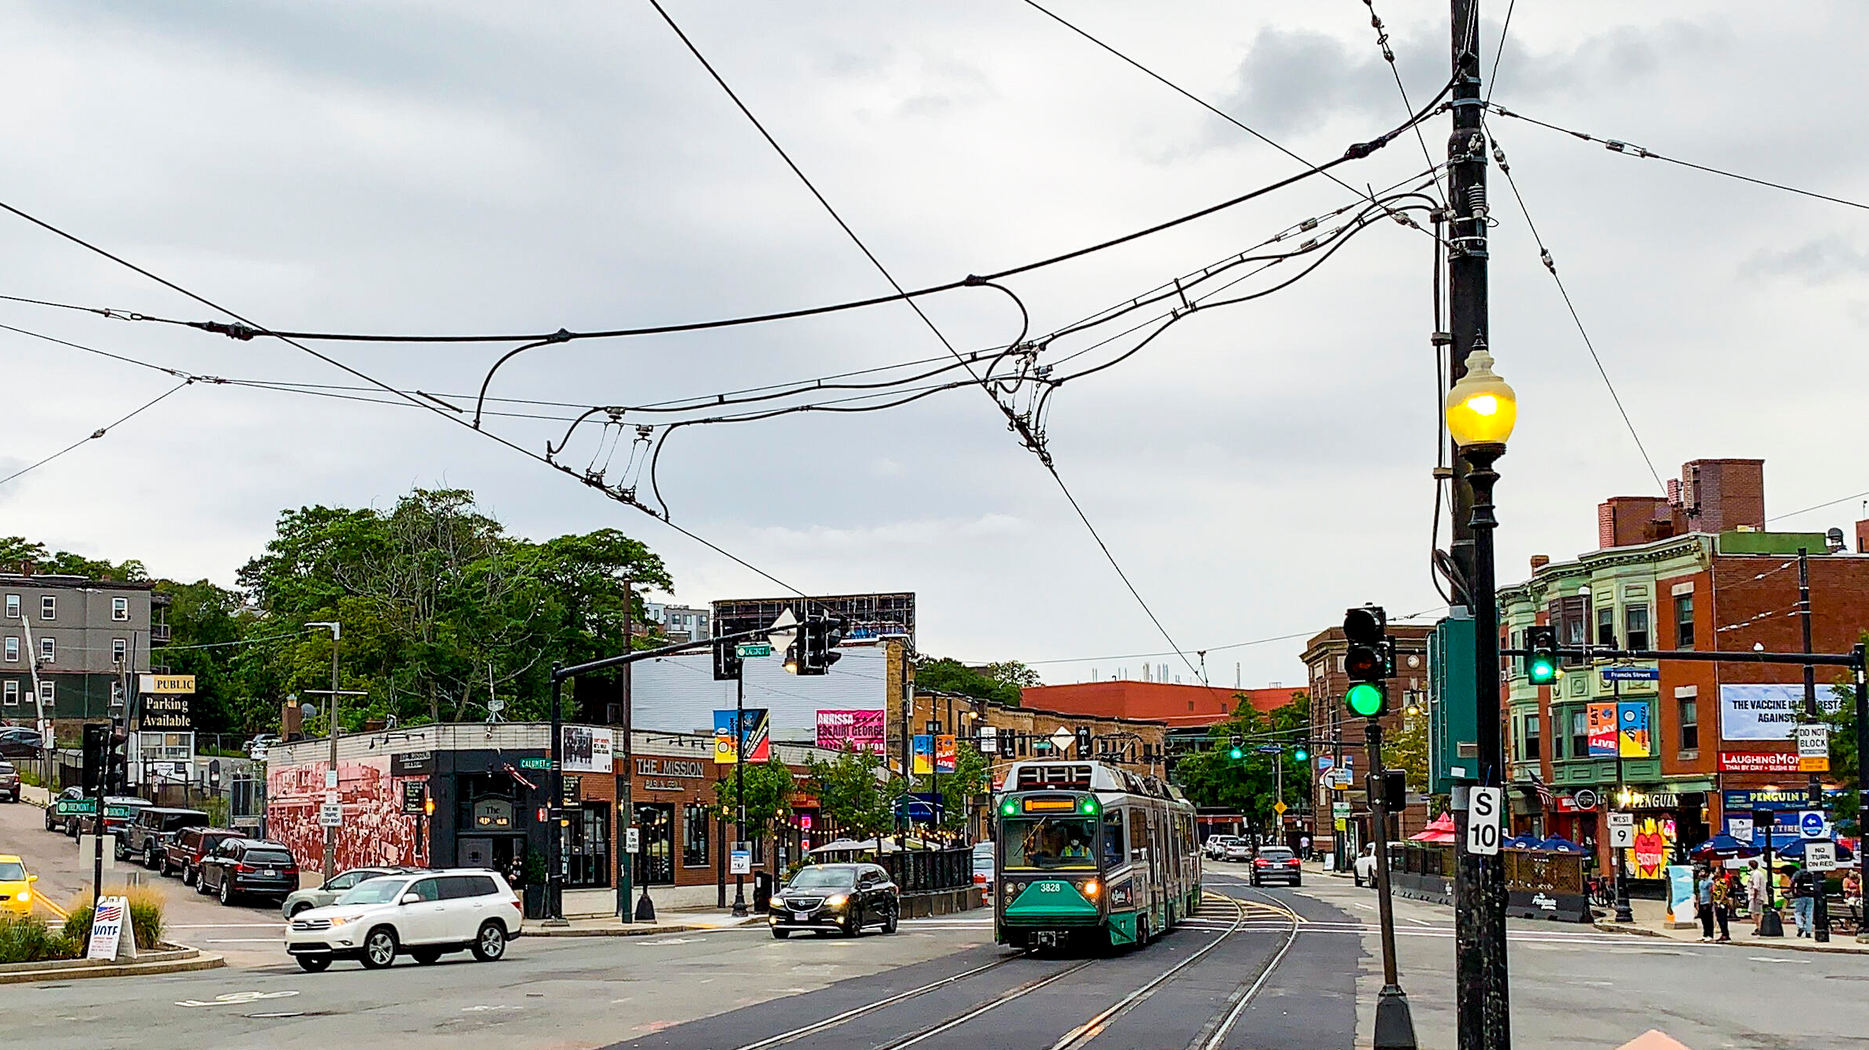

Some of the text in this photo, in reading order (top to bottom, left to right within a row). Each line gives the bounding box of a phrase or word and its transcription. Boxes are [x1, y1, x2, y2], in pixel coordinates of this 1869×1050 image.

[157, 679, 194, 690] PUBLIC
[145, 697, 189, 714] Parking
[1732, 700, 1749, 710] THE
[1750, 700, 1787, 710] VACCINE
[142, 714, 192, 727] Available
[1590, 706, 1599, 726] EAT
[851, 725, 885, 737] GEORGE
[1589, 723, 1615, 737] PLAY
[1799, 728, 1826, 737] DO NOT
[1591, 738, 1616, 749] LIVE
[1799, 738, 1826, 748] BLOCK
[936, 748, 955, 759] PLAY
[1721, 752, 1800, 764] LAUGHINGMON
[521, 759, 546, 768] CALUMET
[636, 758, 704, 776] THE MISSION
[936, 759, 954, 769] LIVE
[1632, 794, 1679, 808] PENGUIN
[1749, 792, 1800, 802] PENGUIN
[1475, 792, 1493, 817] S
[485, 806, 500, 815] The
[1778, 825, 1800, 833] TIRE
[1470, 823, 1497, 848] 10
[1617, 829, 1627, 843] 9
[1040, 883, 1061, 892] 3828
[93, 924, 119, 936] VOTE
